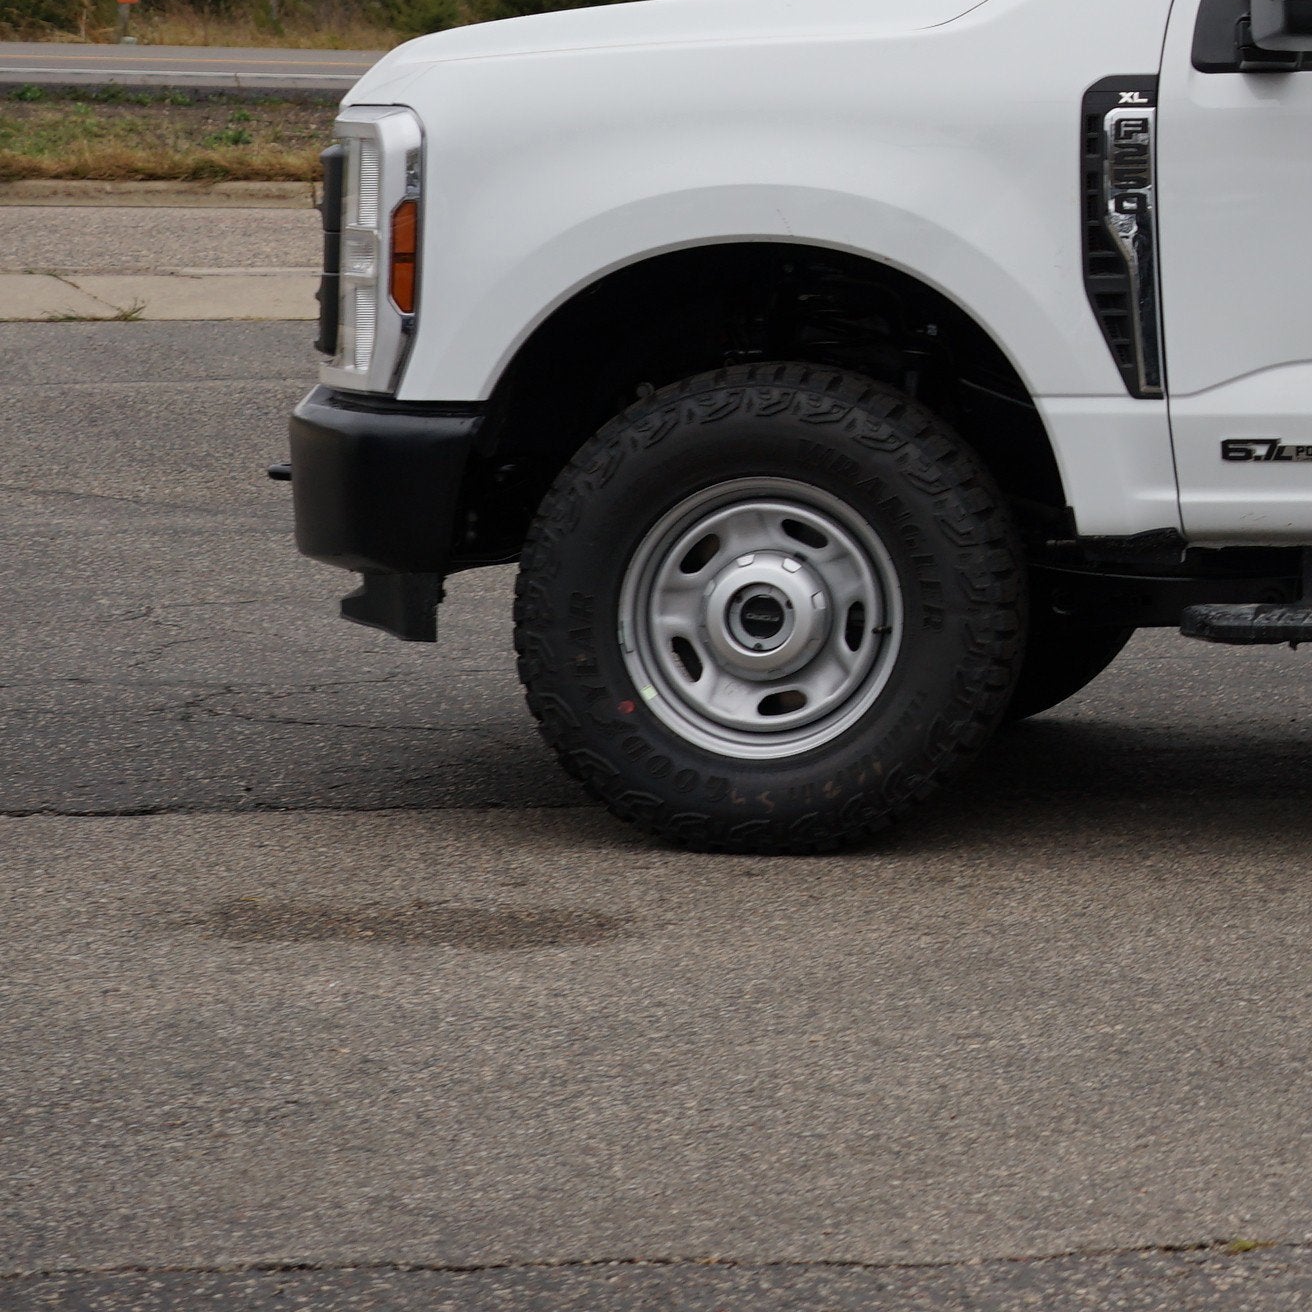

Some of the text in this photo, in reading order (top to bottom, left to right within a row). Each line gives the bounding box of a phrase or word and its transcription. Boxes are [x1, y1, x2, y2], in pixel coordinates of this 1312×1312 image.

[1118, 92, 1148, 103] XL
[1222, 438, 1292, 461] 6.7L
[569, 591, 732, 803] GOODYEAR
